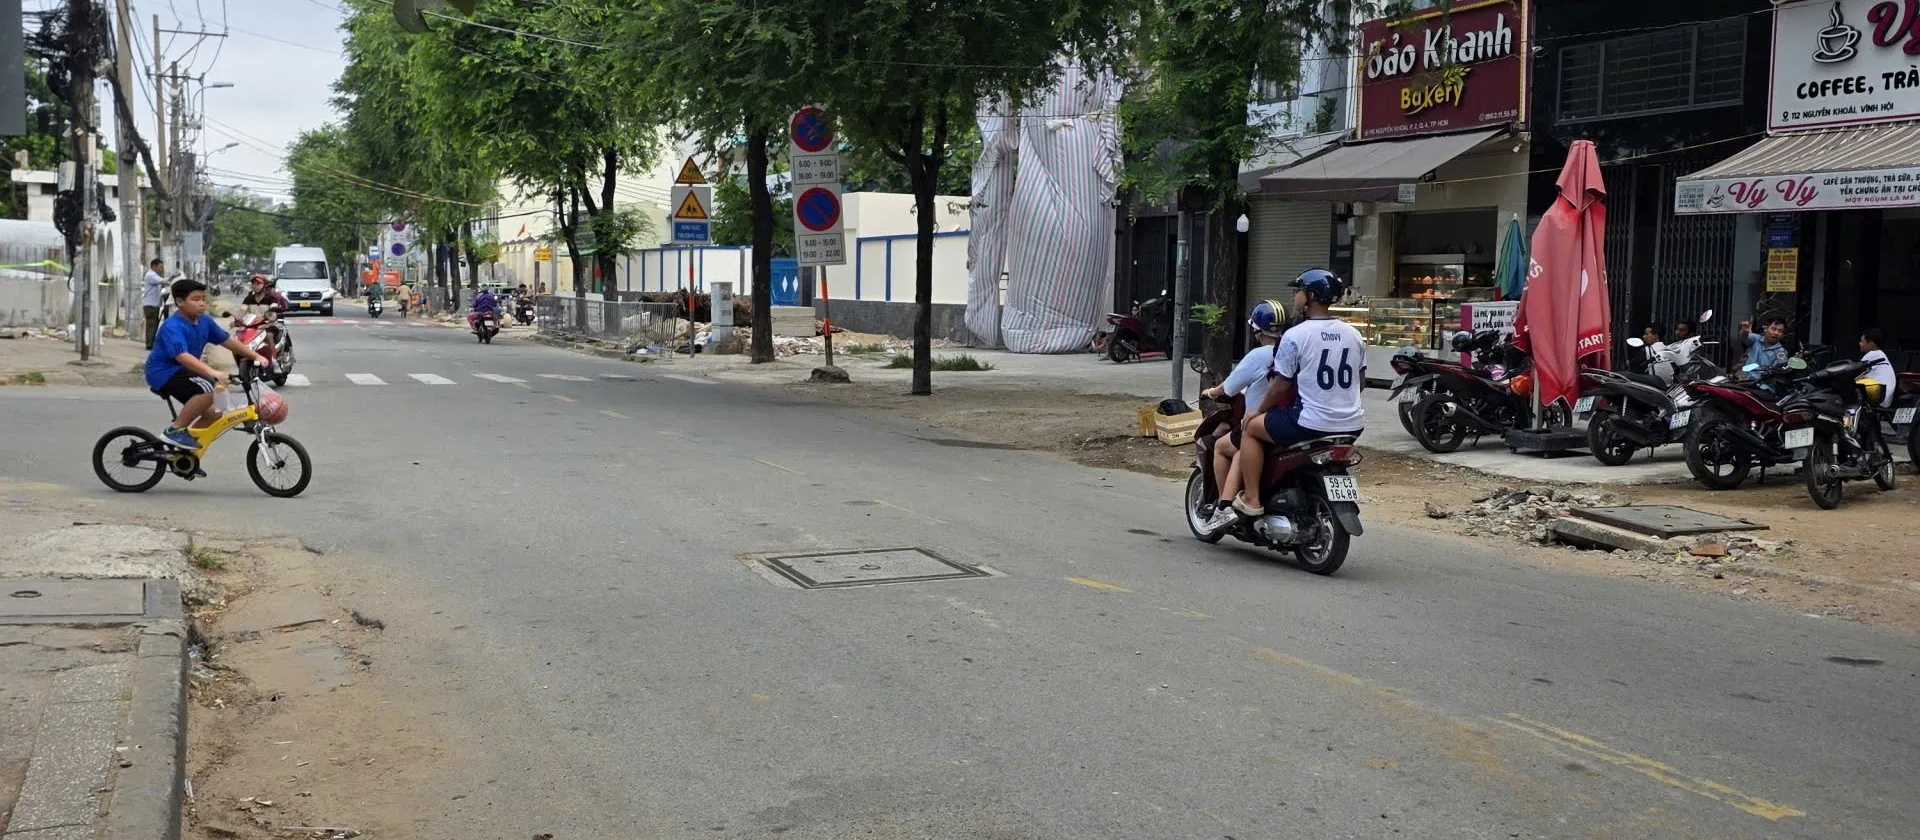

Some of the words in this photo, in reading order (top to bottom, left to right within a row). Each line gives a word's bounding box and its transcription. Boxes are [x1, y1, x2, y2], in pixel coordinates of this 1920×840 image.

[1424, 13, 1512, 69] Khanh
[1797, 75, 1874, 99] COFFEE,
[1400, 82, 1465, 114] Bakery
[1791, 111, 1801, 120] 112
[1728, 179, 1769, 208] Vy
[1776, 176, 1819, 206] Vy
[1321, 331, 1341, 342] Chovy
[1577, 333, 1604, 352] TART
[1316, 347, 1353, 391] 66
[1329, 477, 1353, 488] 59-C3
[1330, 489, 1358, 500] 164.88
